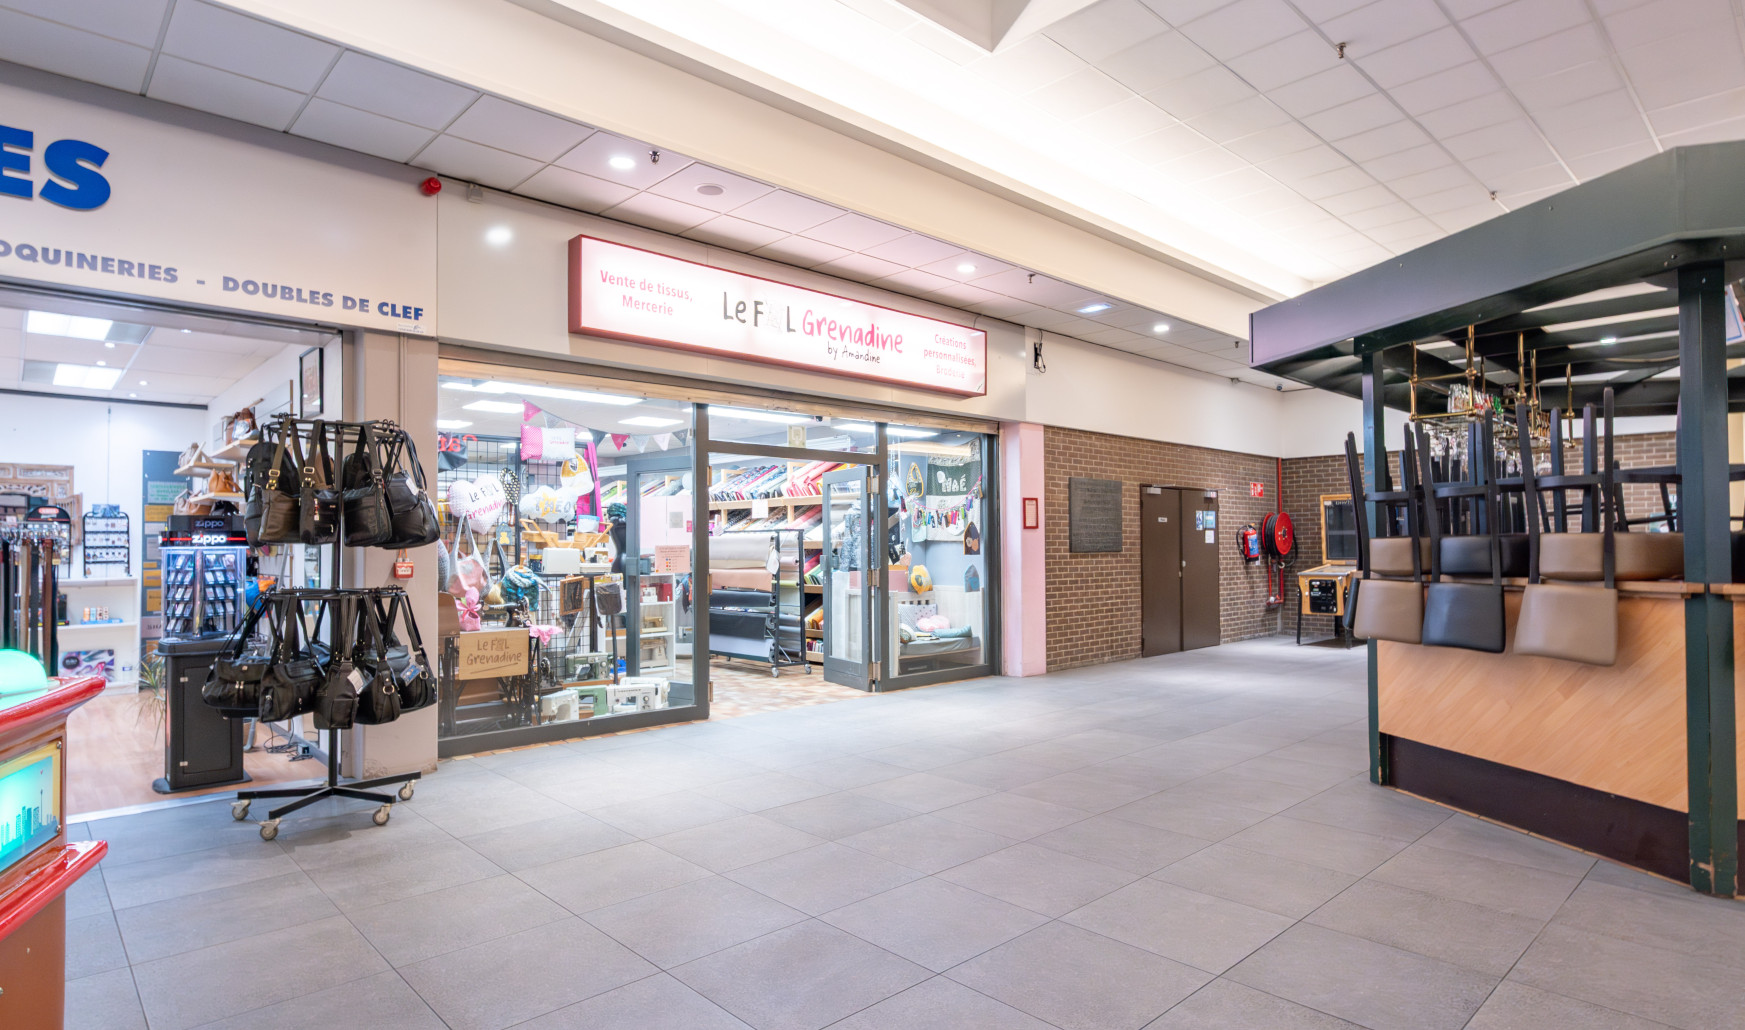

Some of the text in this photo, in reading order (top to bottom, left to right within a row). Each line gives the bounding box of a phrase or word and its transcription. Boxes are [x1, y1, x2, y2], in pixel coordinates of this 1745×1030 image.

[600, 269, 693, 303] Vente de tissus,
[222, 275, 334, 307] DOUBLES
[342, 295, 370, 313] DE
[377, 301, 424, 321] CLEF
[622, 294, 674, 316] Mercerie
[723, 291, 747, 324] Le
[802, 309, 903, 354] Grenadine
[827, 341, 881, 364] by Amandine
[477, 639, 489, 652] Le
[466, 651, 522, 666] Grenadine
